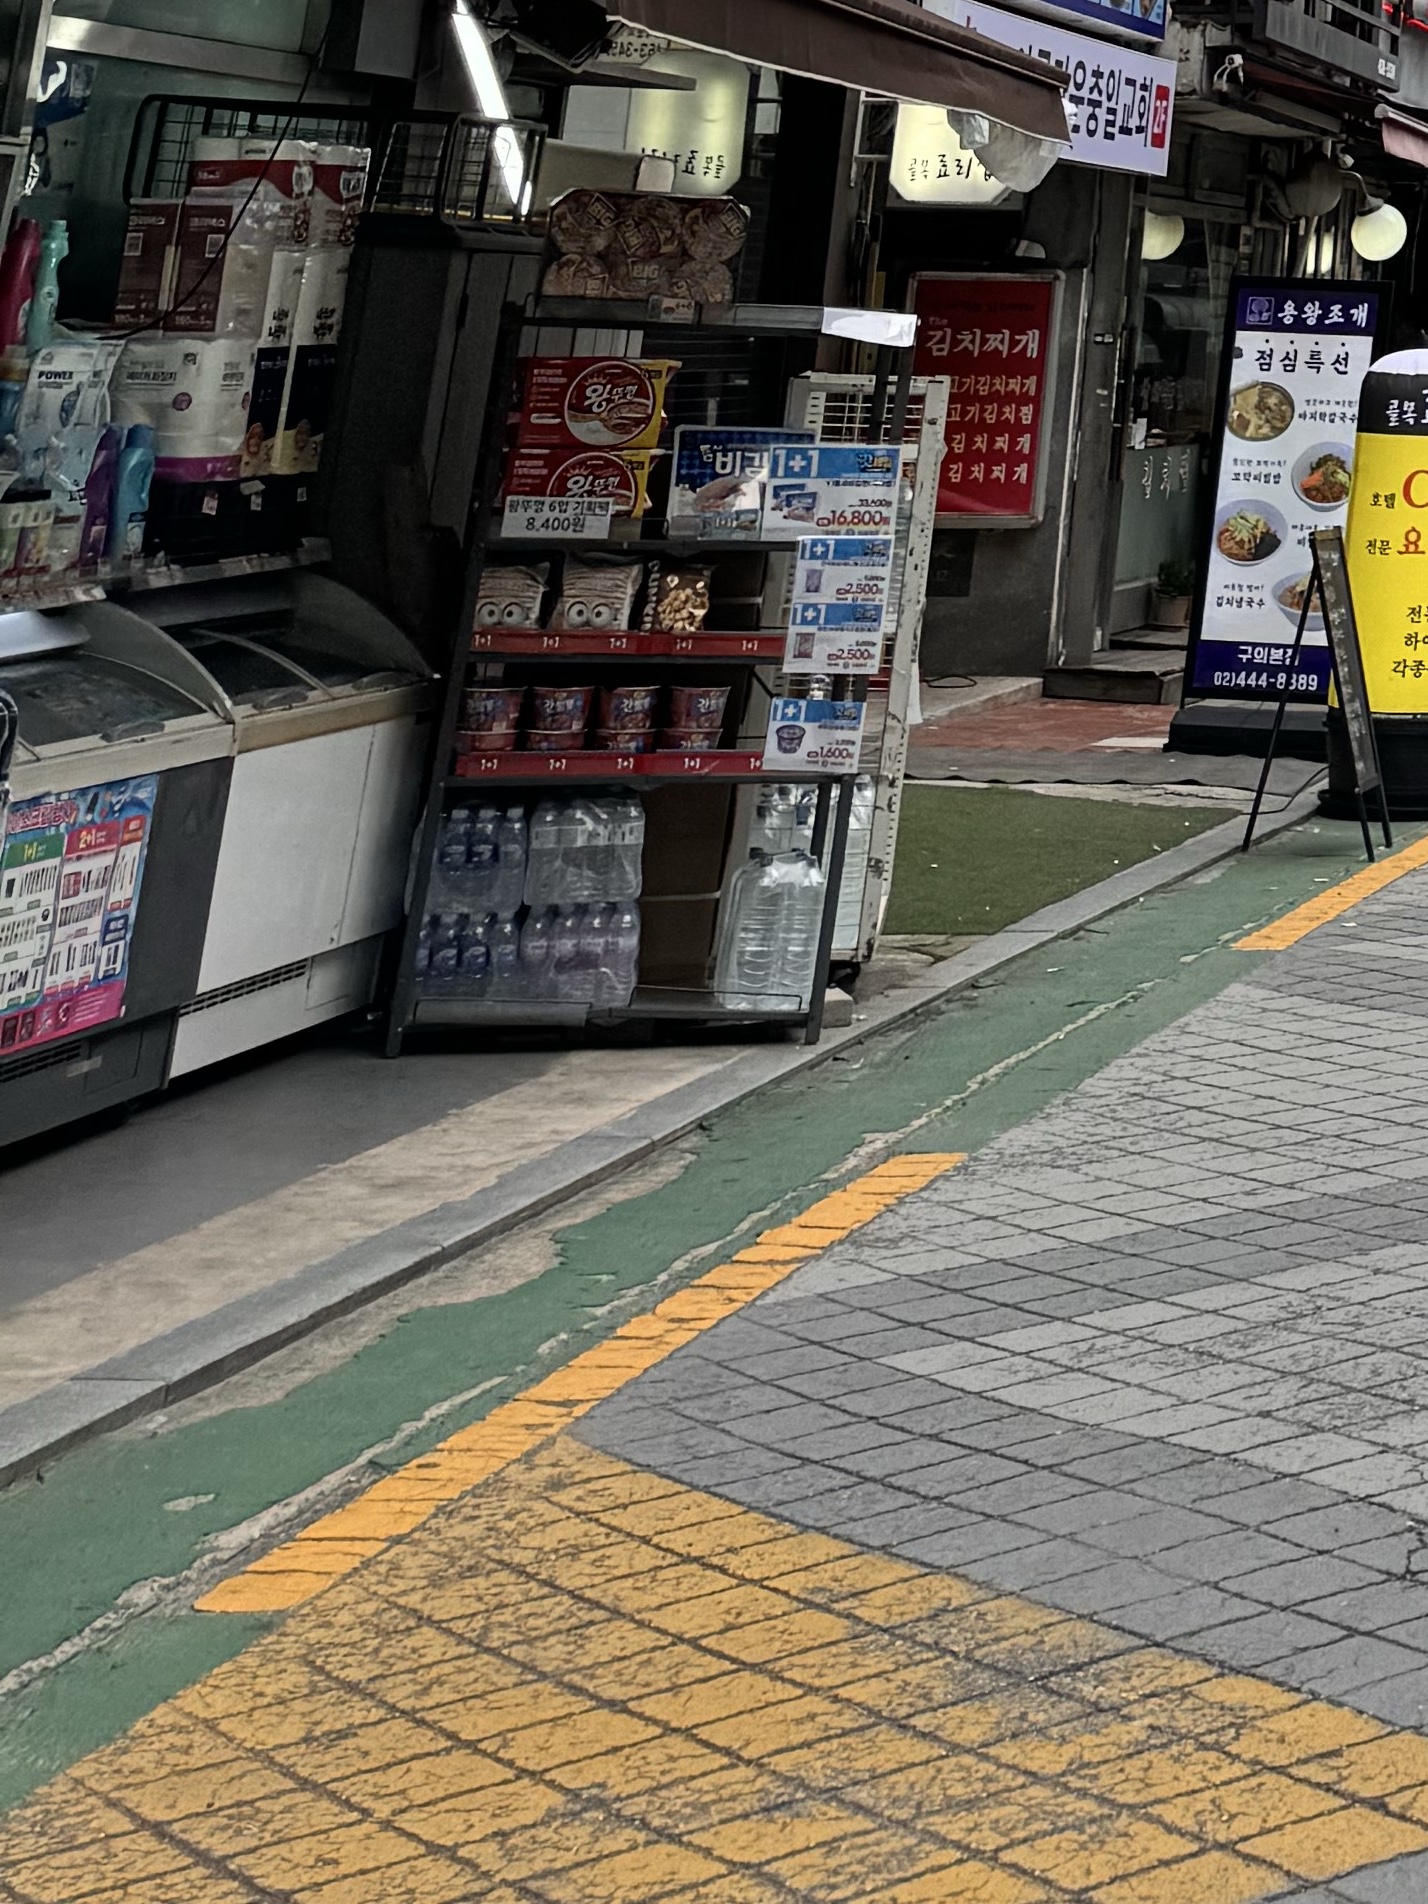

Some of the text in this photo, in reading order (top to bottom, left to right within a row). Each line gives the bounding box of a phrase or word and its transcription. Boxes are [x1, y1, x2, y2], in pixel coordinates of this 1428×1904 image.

[1277, 299, 1369, 329] 용왕조개
[925, 327, 1041, 359] 김치찌개
[1254, 346, 1351, 375] 점심특선
[950, 432, 1032, 456] 김치찌개
[773, 450, 819, 479] 1+1
[947, 462, 1030, 486] 김치찌개
[524, 515, 587, 534] 8,400원
[802, 539, 835, 559] 1+1
[793, 604, 828, 624] 1+1
[771, 700, 806, 722] 1+1
